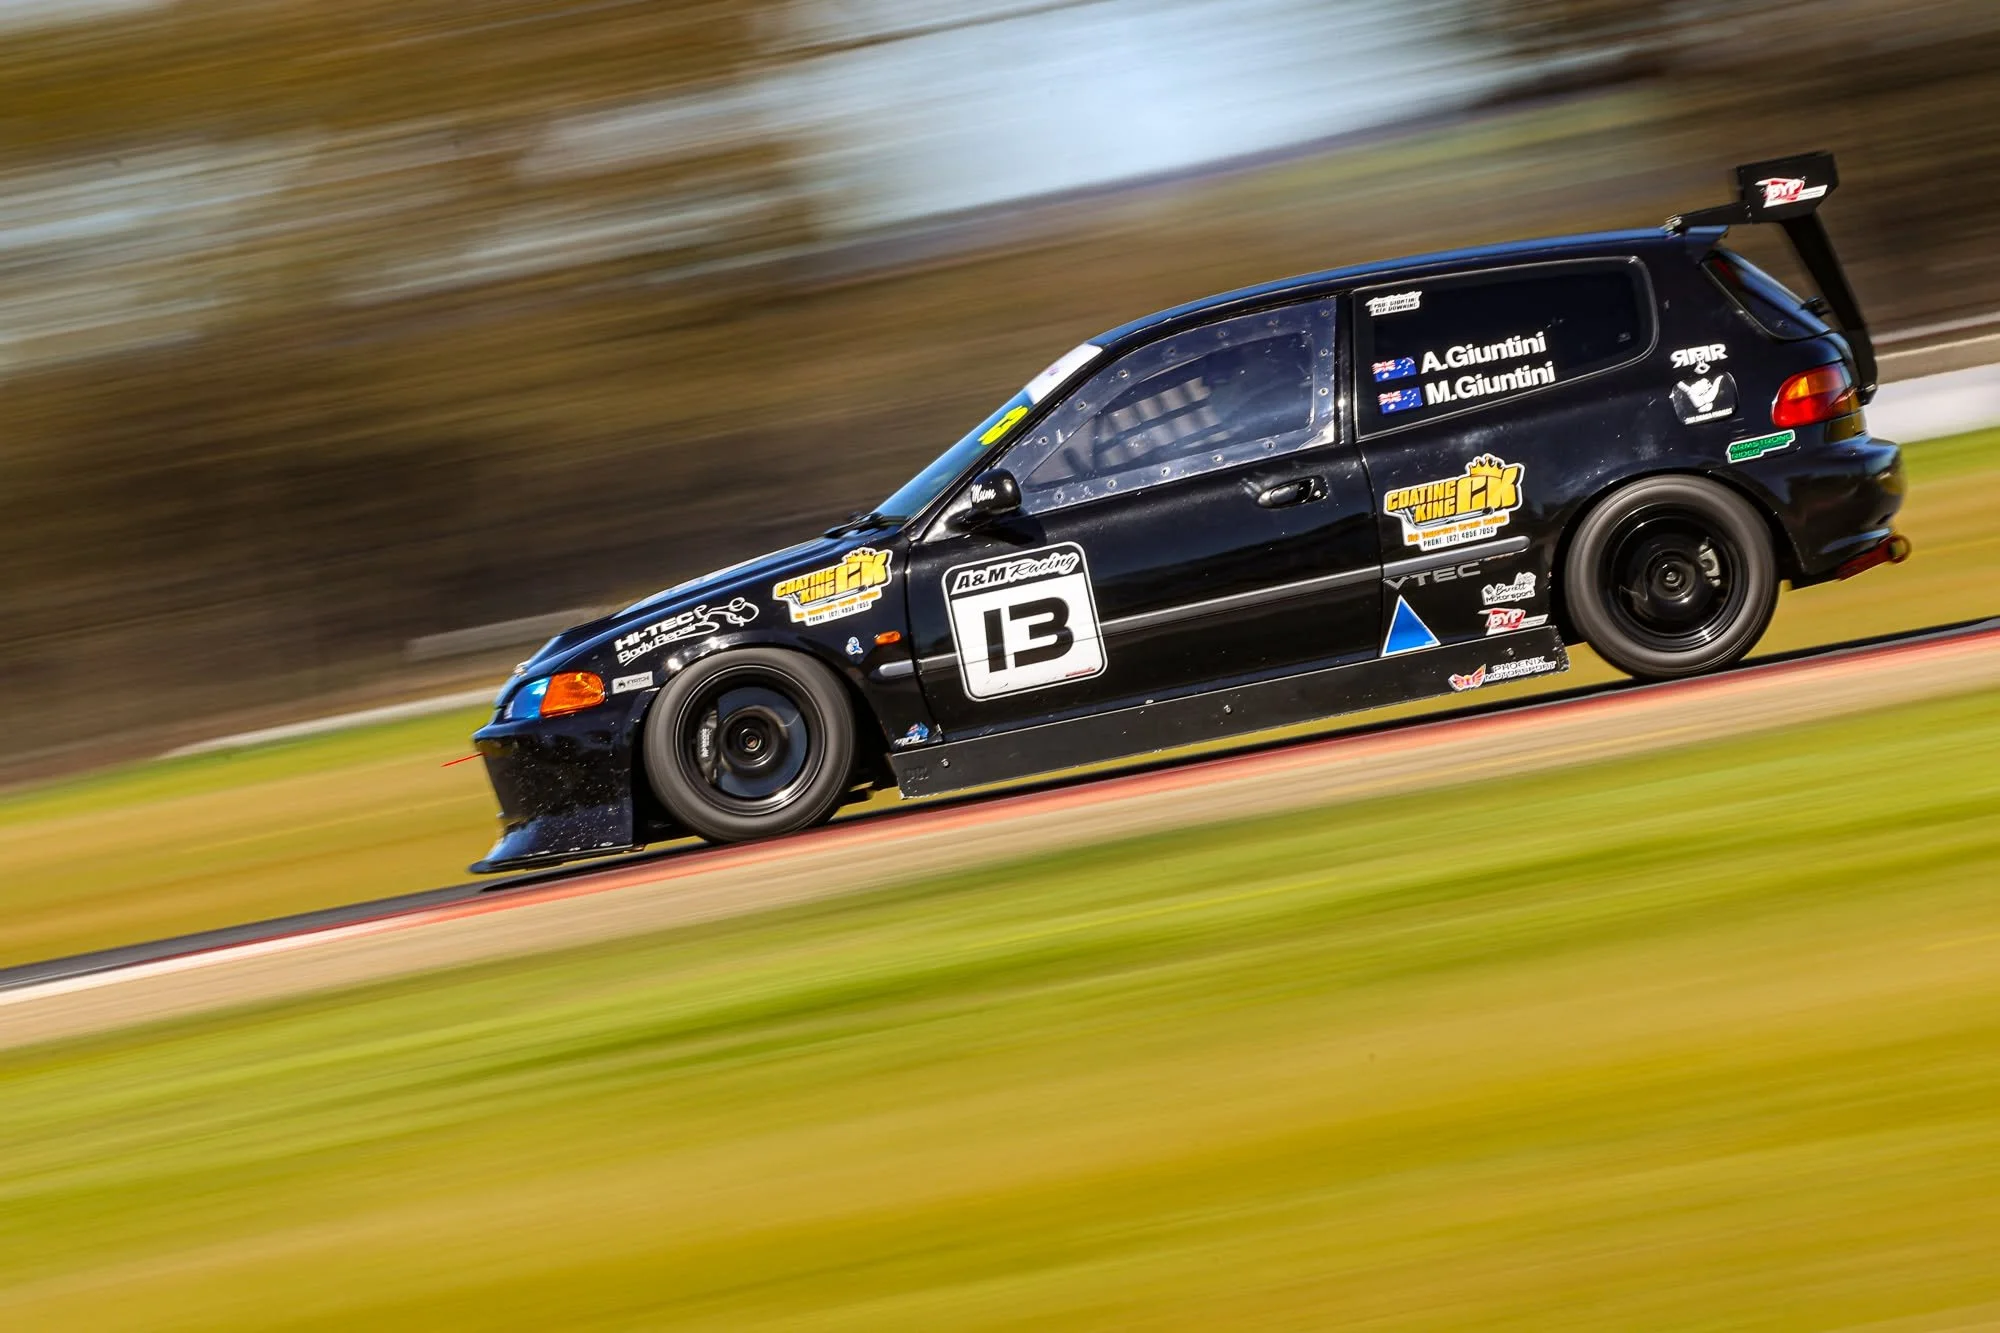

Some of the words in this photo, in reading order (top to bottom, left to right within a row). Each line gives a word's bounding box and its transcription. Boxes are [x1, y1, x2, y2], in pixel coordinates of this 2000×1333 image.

[1421, 331, 1547, 375] A.Giuntini
[1425, 361, 1556, 405] M.Giuntini
[971, 484, 996, 503] Mum
[1387, 479, 1456, 511] COATING
[1415, 497, 1456, 523] KING
[1009, 554, 1077, 578] Racing
[1383, 562, 1481, 590] VTEC
[776, 567, 836, 597] COATING
[800, 581, 836, 604] KING
[1485, 589, 1534, 603] Motorsport
[1489, 609, 1523, 627] BYP
[614, 611, 695, 652] HI-TEC
[984, 597, 1074, 673] 13
[617, 641, 654, 664] Body
[1492, 656, 1545, 673] PHOENIX
[1485, 661, 1557, 681] MOTORSPORT
